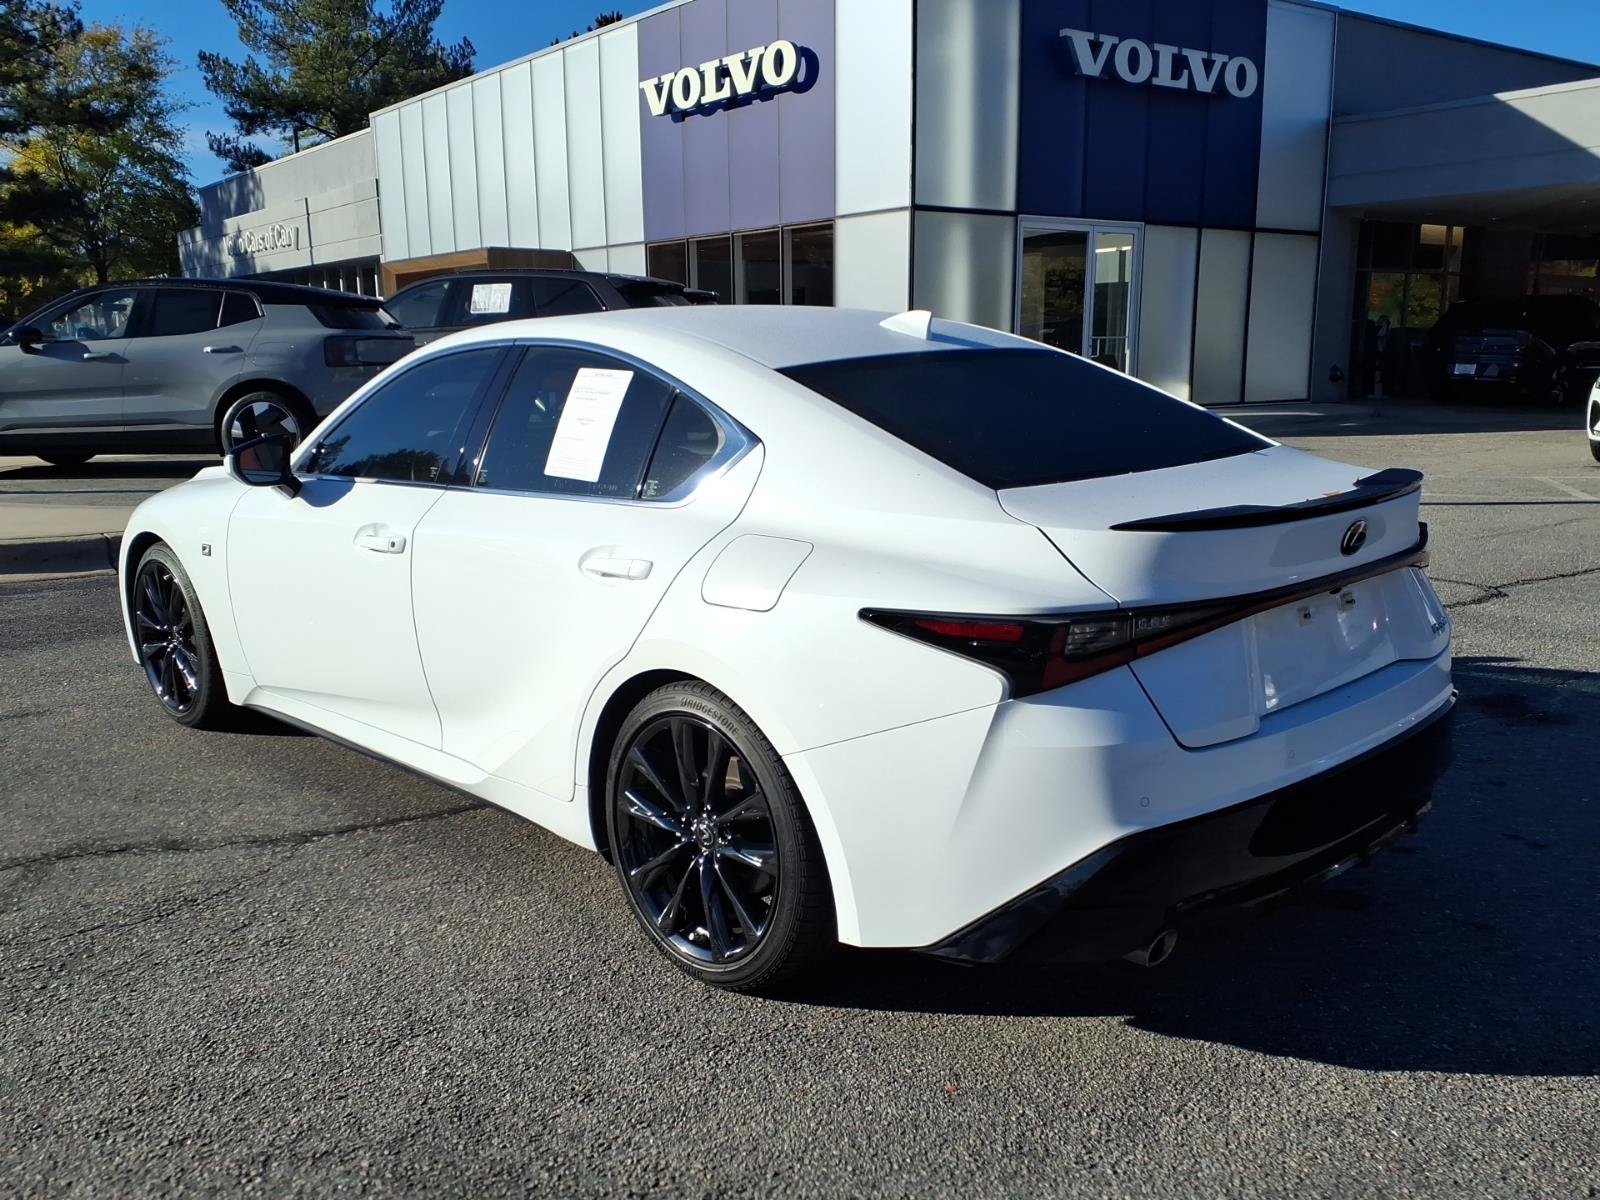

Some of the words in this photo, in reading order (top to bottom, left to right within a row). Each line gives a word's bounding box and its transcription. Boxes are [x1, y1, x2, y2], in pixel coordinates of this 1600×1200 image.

[639, 40, 797, 116] VOLVO
[1059, 28, 1258, 98] VOLVO
[223, 232, 244, 255] Voo
[245, 231, 264, 252] Cars
[264, 225, 275, 249] of
[274, 224, 294, 248] Cary
[680, 697, 739, 736] BRIDGESTONE
